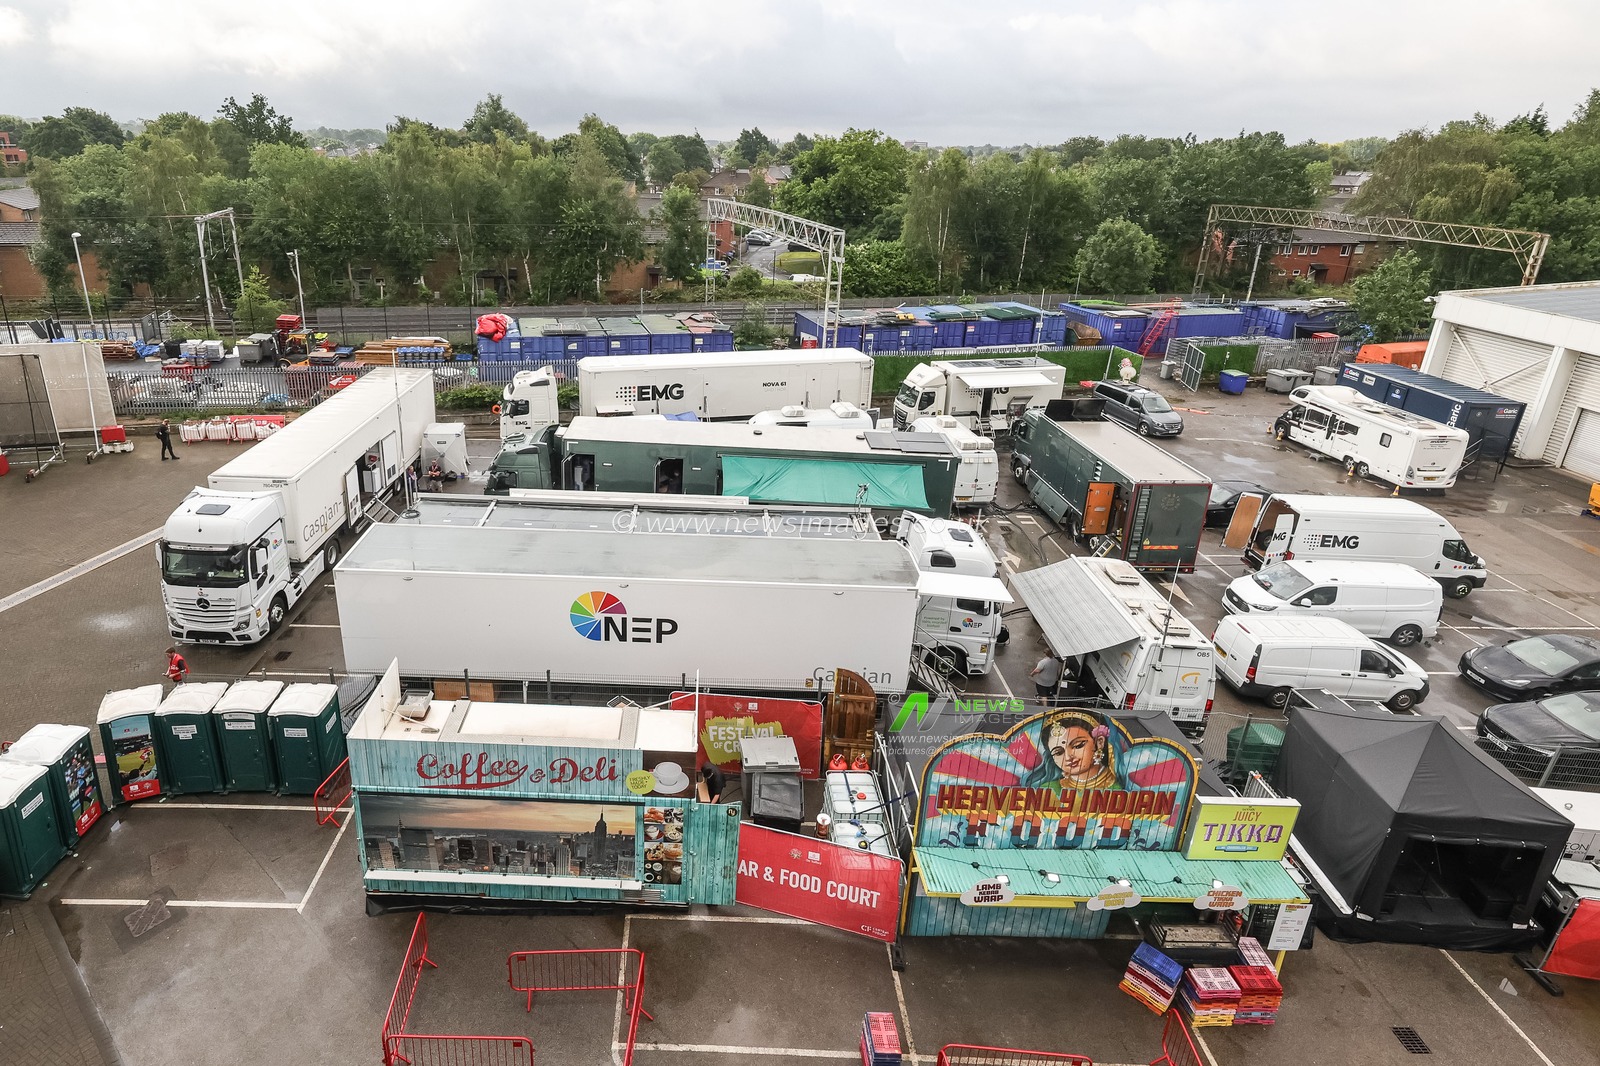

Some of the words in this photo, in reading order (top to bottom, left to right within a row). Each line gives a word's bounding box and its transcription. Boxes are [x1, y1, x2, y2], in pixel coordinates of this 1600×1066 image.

[637, 383, 685, 401] EMG
[1446, 404, 1462, 428] Garic
[1273, 532, 1287, 541] MG
[1320, 534, 1360, 549] EMG
[604, 616, 678, 643] NEP
[813, 667, 892, 684] Caian
[713, 740, 723, 749] OF
[417, 752, 528, 788] Coffee
[530, 768, 545, 783] &
[550, 757, 619, 784] Deli
[937, 785, 1076, 813] HEAVENLY
[1081, 789, 1176, 815] INDIAN
[1232, 811, 1262, 822] JUICY
[963, 813, 1132, 849] FOOD
[1203, 823, 1284, 843] TIKKA
[737, 859, 759, 879] AR
[763, 866, 775, 883] &
[779, 868, 822, 894] FOOD
[826, 880, 881, 908] COURT
[976, 883, 1002, 891] LAMB
[973, 895, 1004, 903] WRAP
